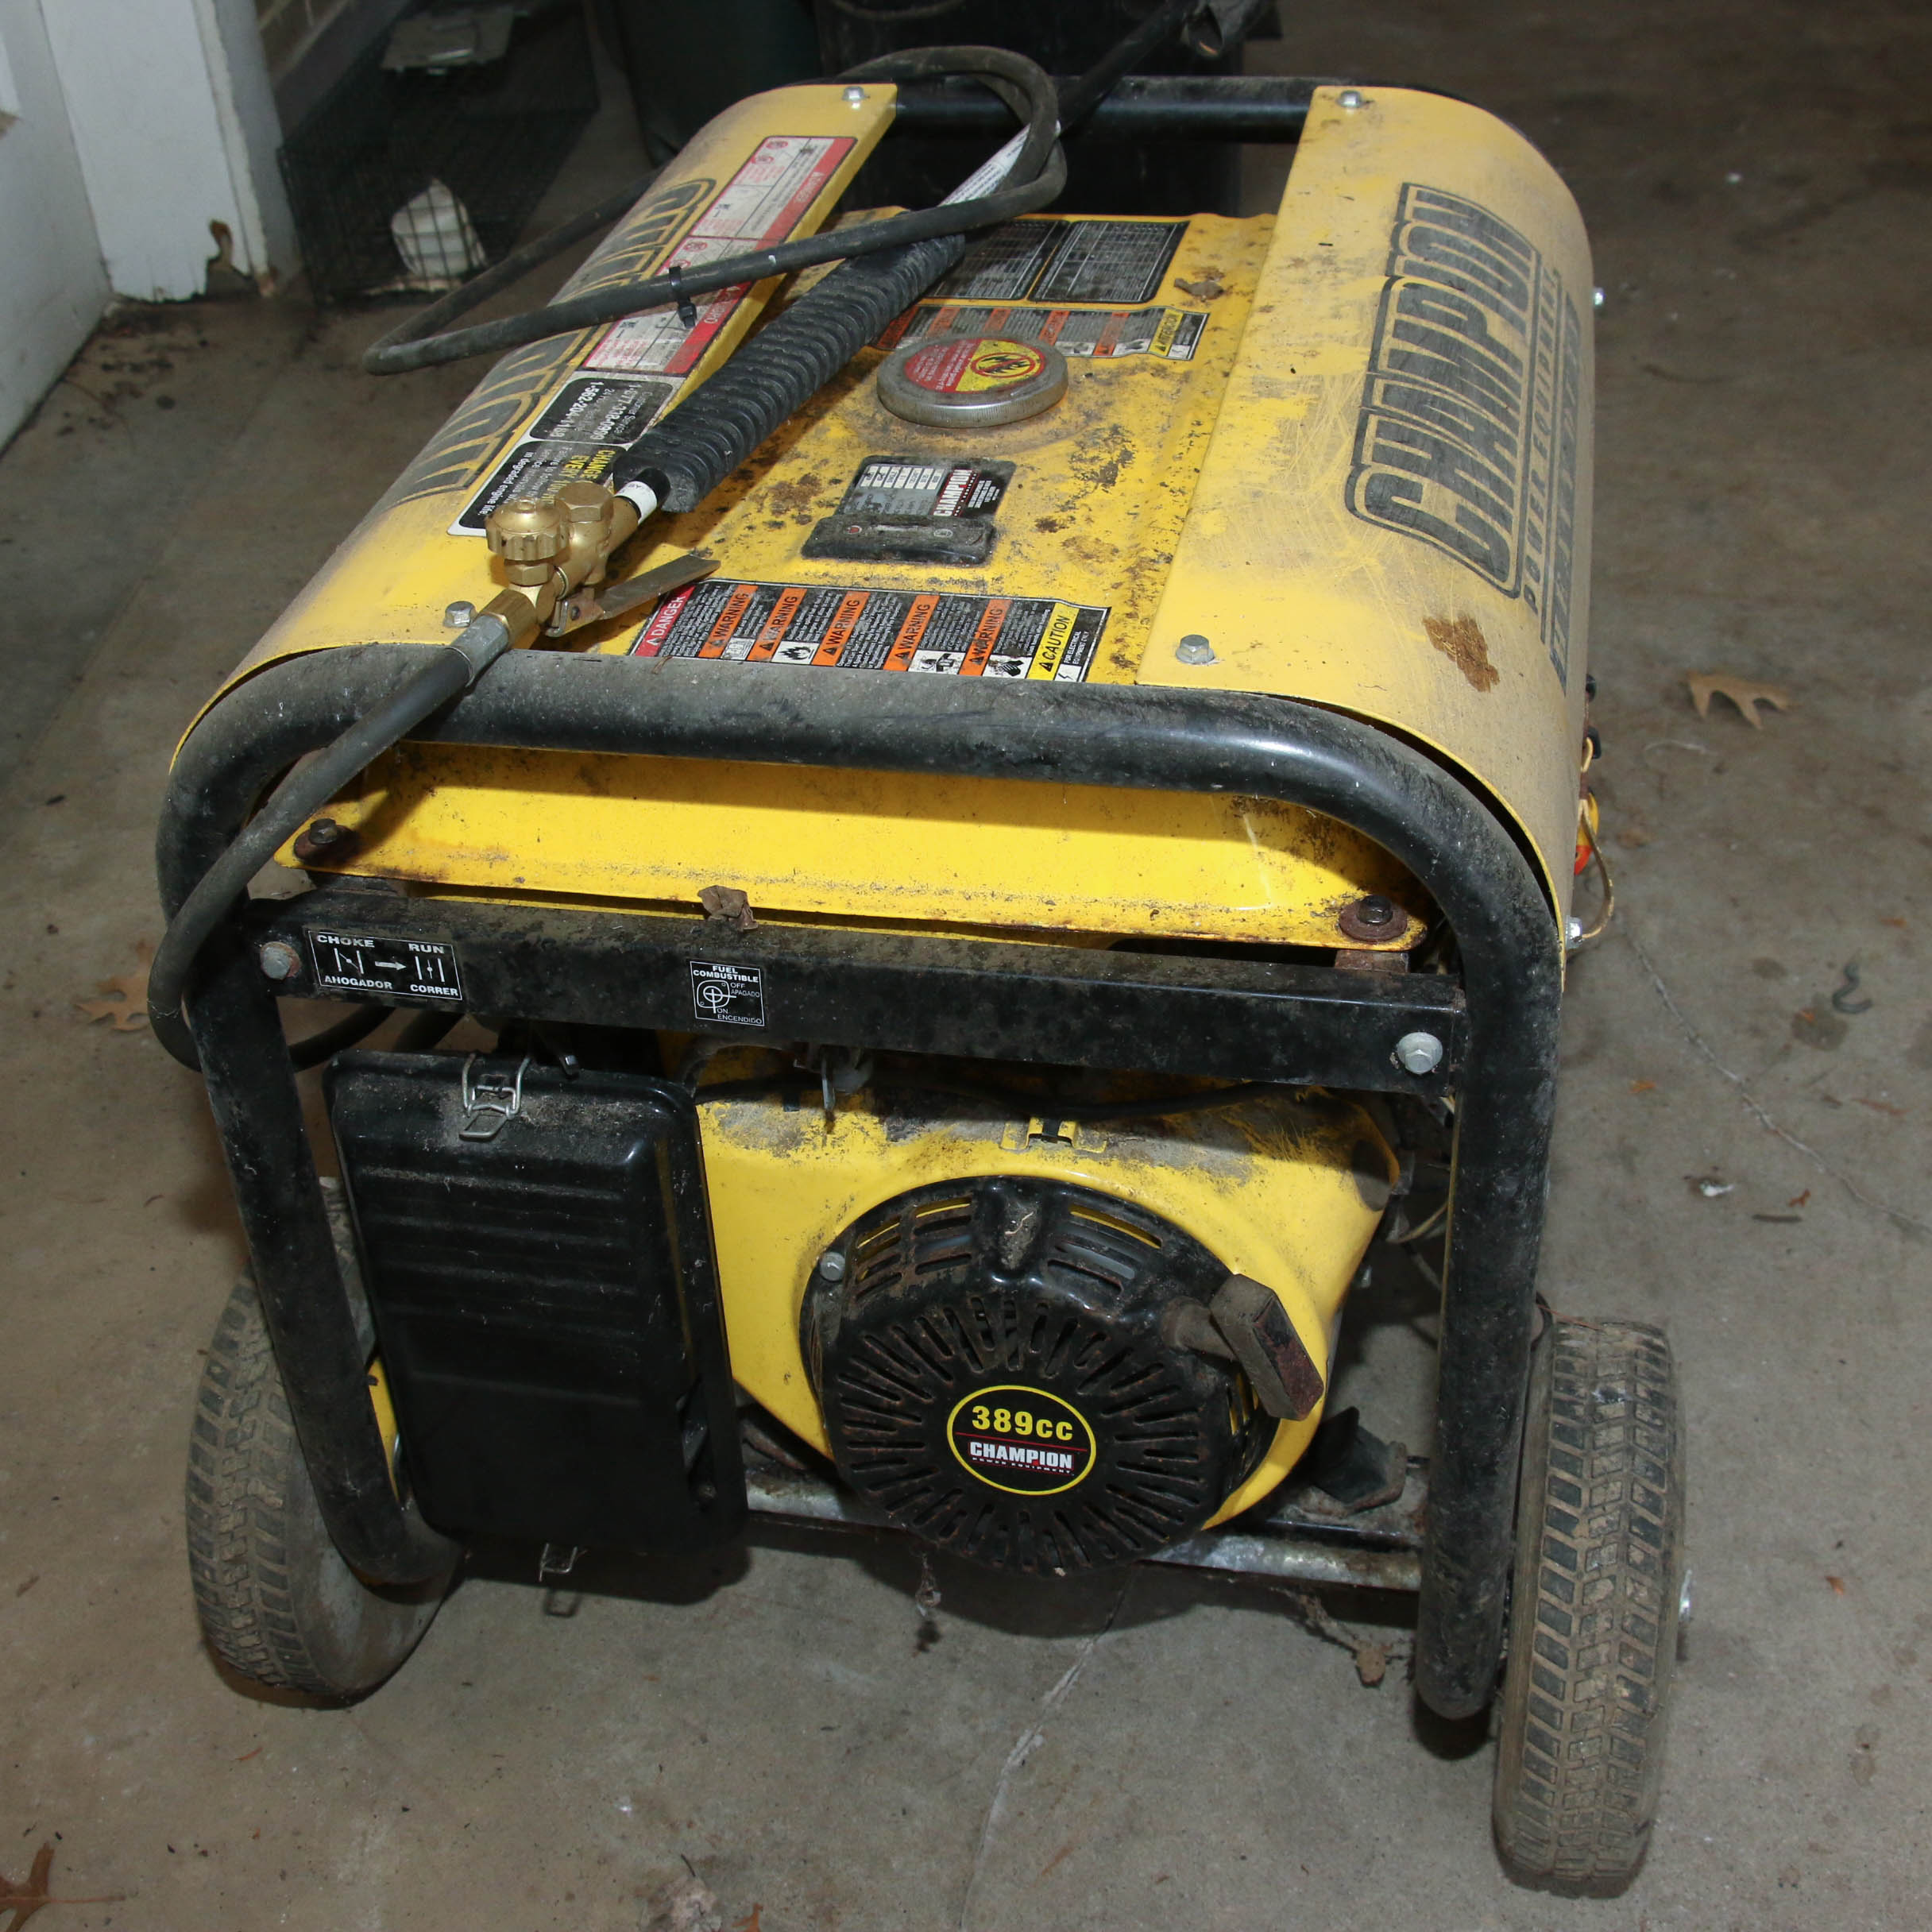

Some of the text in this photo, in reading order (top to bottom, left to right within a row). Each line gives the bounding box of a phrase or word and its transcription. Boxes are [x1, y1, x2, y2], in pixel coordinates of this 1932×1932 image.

[1362, 186, 1535, 585] CHAMPION
[505, 458, 531, 485] degraded
[558, 454, 591, 479] EVERY
[579, 450, 616, 479] CHANGE
[486, 484, 509, 505] engine
[933, 469, 973, 516] CHAMPION
[477, 504, 497, 516] life.
[651, 596, 686, 636] DANGER
[712, 592, 749, 637] WARNING
[762, 596, 798, 639] WARNING
[825, 599, 861, 645] WARNING
[897, 604, 931, 649] WARNING
[971, 608, 1003, 655] WARNING
[1041, 615, 1071, 659] CAUTION
[1063, 630, 1081, 663] FOR ELECTRICAL
[317, 934, 445, 954] CHOKE RUN
[693, 969, 759, 983] COMBUSTIBLE
[712, 965, 738, 974] FUEL
[324, 975, 458, 996] AHOGADOR CORRER
[731, 989, 760, 998] APAGADO
[717, 1014, 763, 1024] ENCENDIDO
[972, 1405, 1073, 1441] 389cc
[969, 1441, 1073, 1470] CHAMPION
